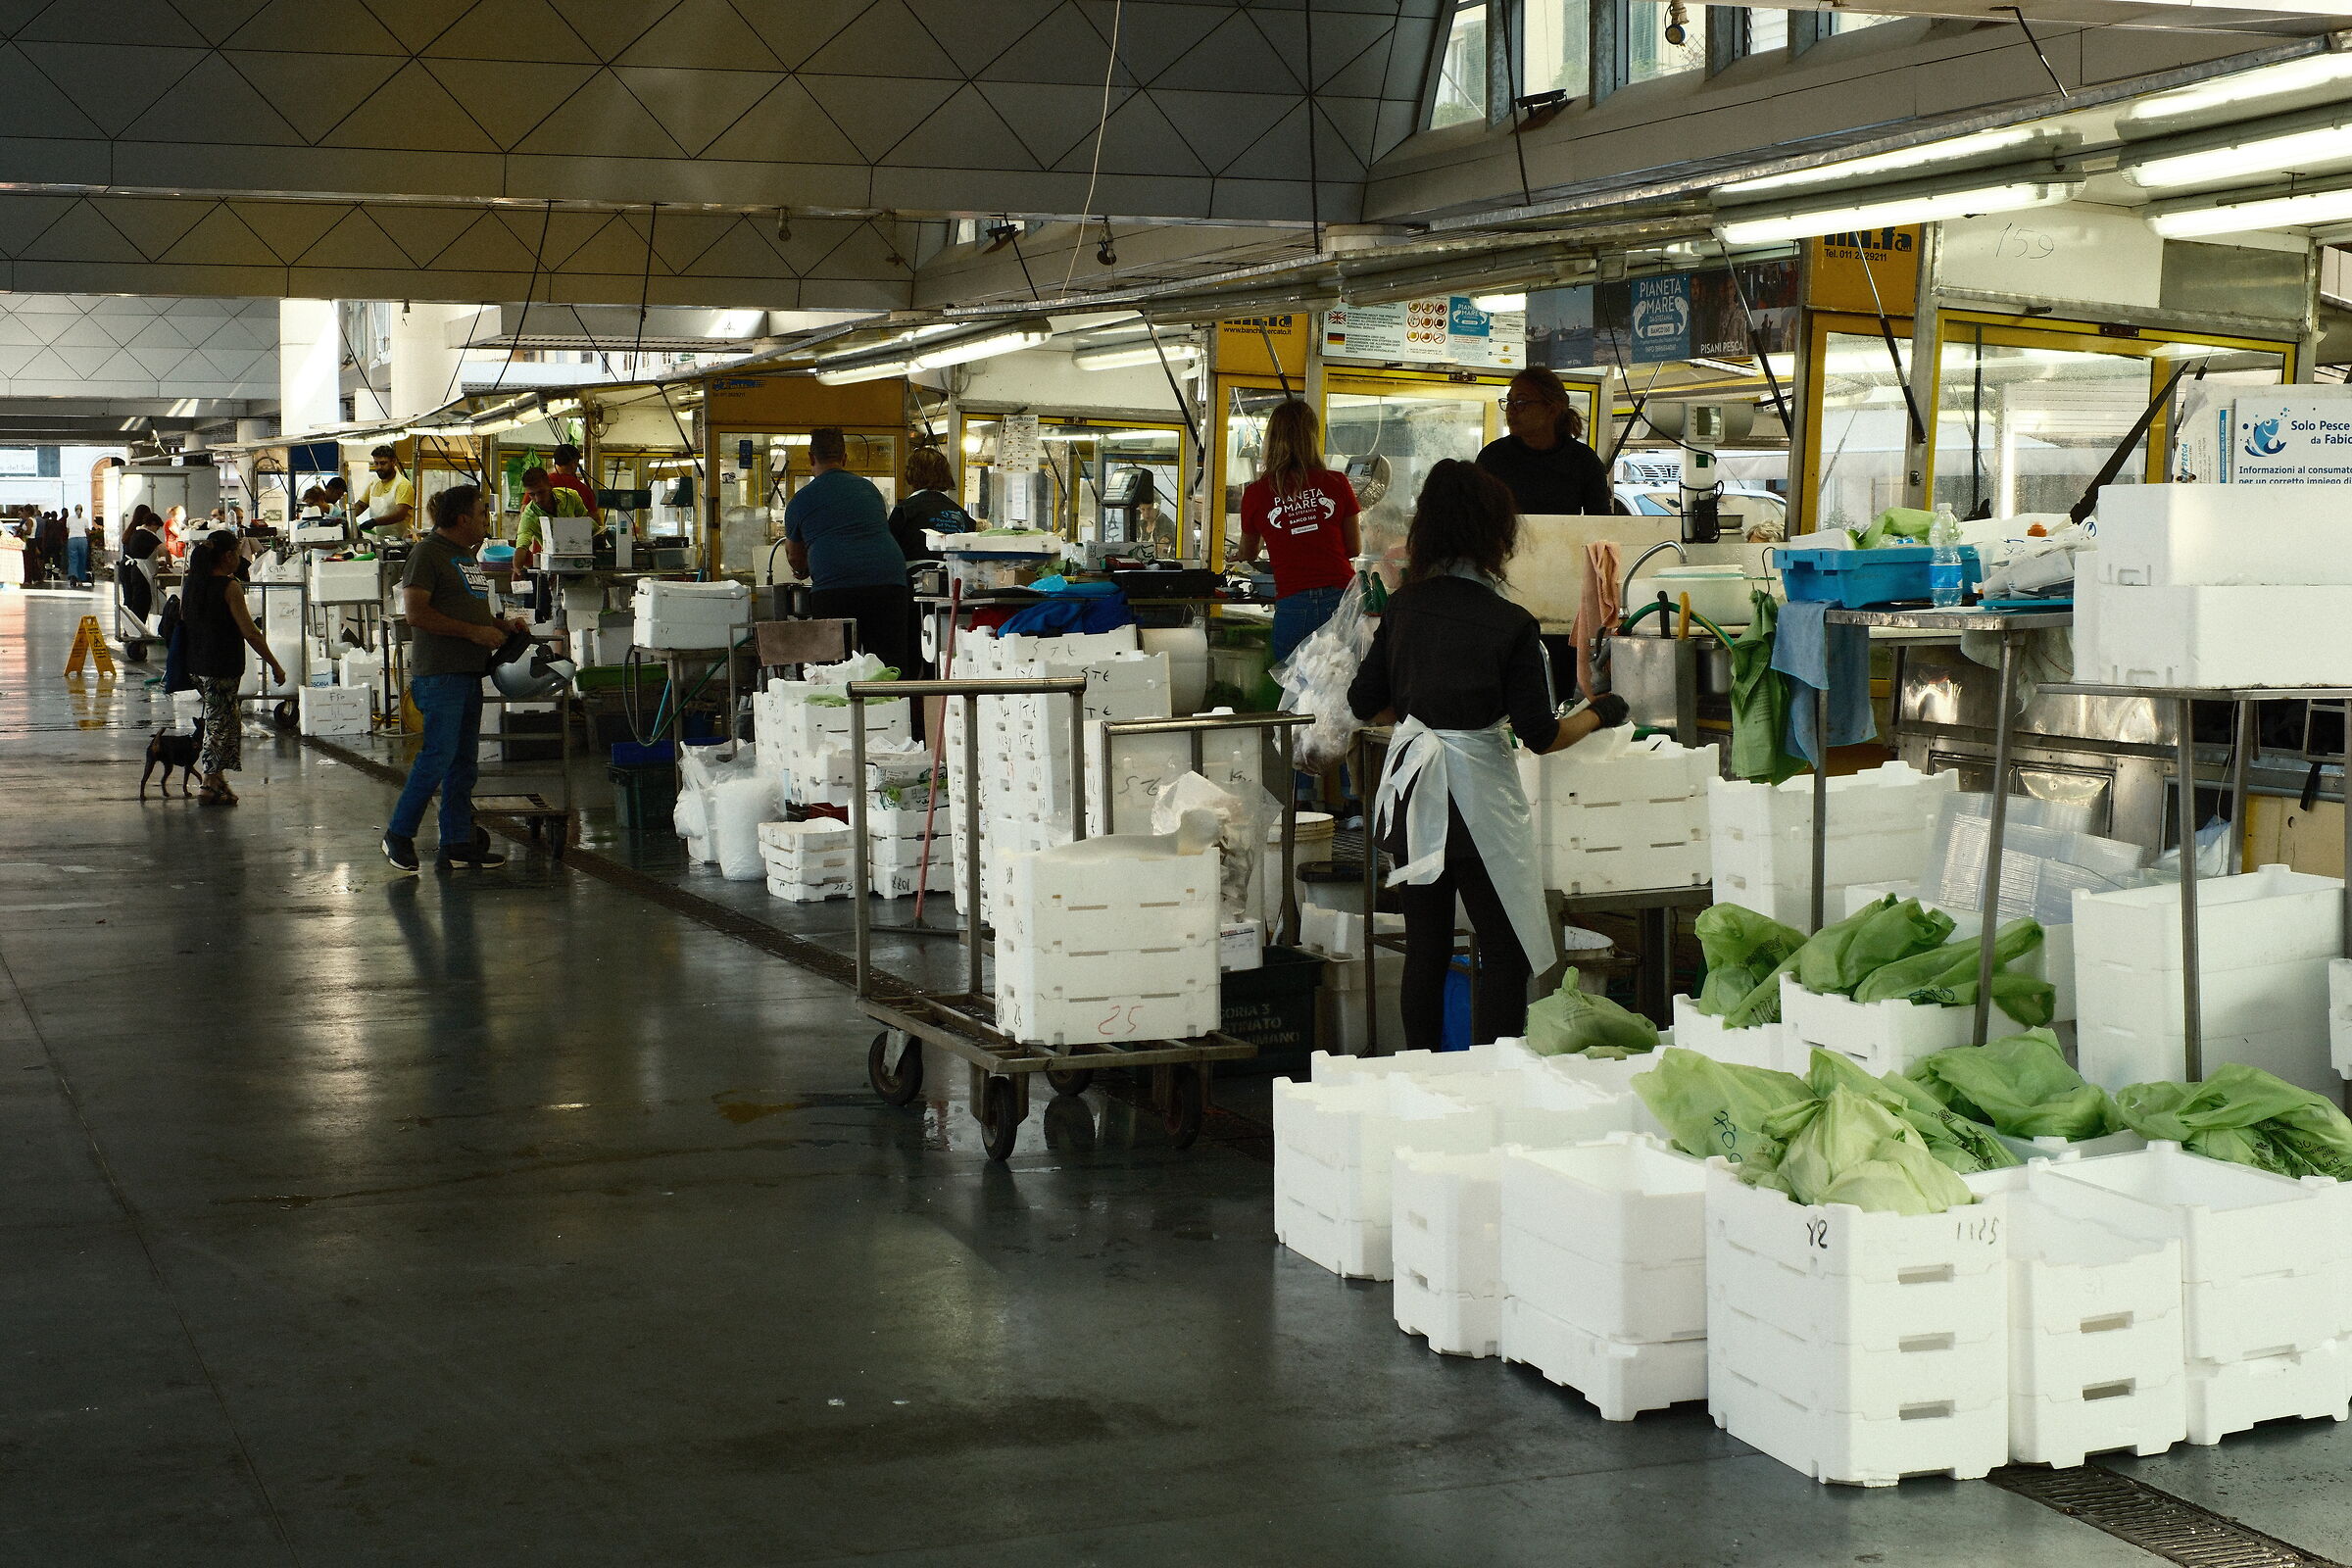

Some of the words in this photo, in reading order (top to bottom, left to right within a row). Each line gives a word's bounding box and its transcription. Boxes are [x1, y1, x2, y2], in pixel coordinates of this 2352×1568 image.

[1995, 221, 2055, 260] 159
[1825, 248, 1838, 259] Tel.
[1839, 250, 1852, 260] 011
[1854, 252, 1887, 263] 229211
[1640, 278, 1683, 298] PIANETA
[1646, 296, 1675, 315] MARE
[1223, 326, 1293, 335] www.banchercato.it
[1700, 343, 1722, 355] PISANI
[1723, 340, 1744, 353] PESCA
[2290, 420, 2316, 431] Solo
[2319, 420, 2350, 431] Pesce
[2310, 436, 2322, 445] da
[2238, 466, 2295, 474] Informazioni
[2297, 466, 2306, 474] al
[1284, 498, 1318, 514] MARE
[1290, 516, 1307, 525] BANCO
[1098, 1004, 1145, 1035] 25
